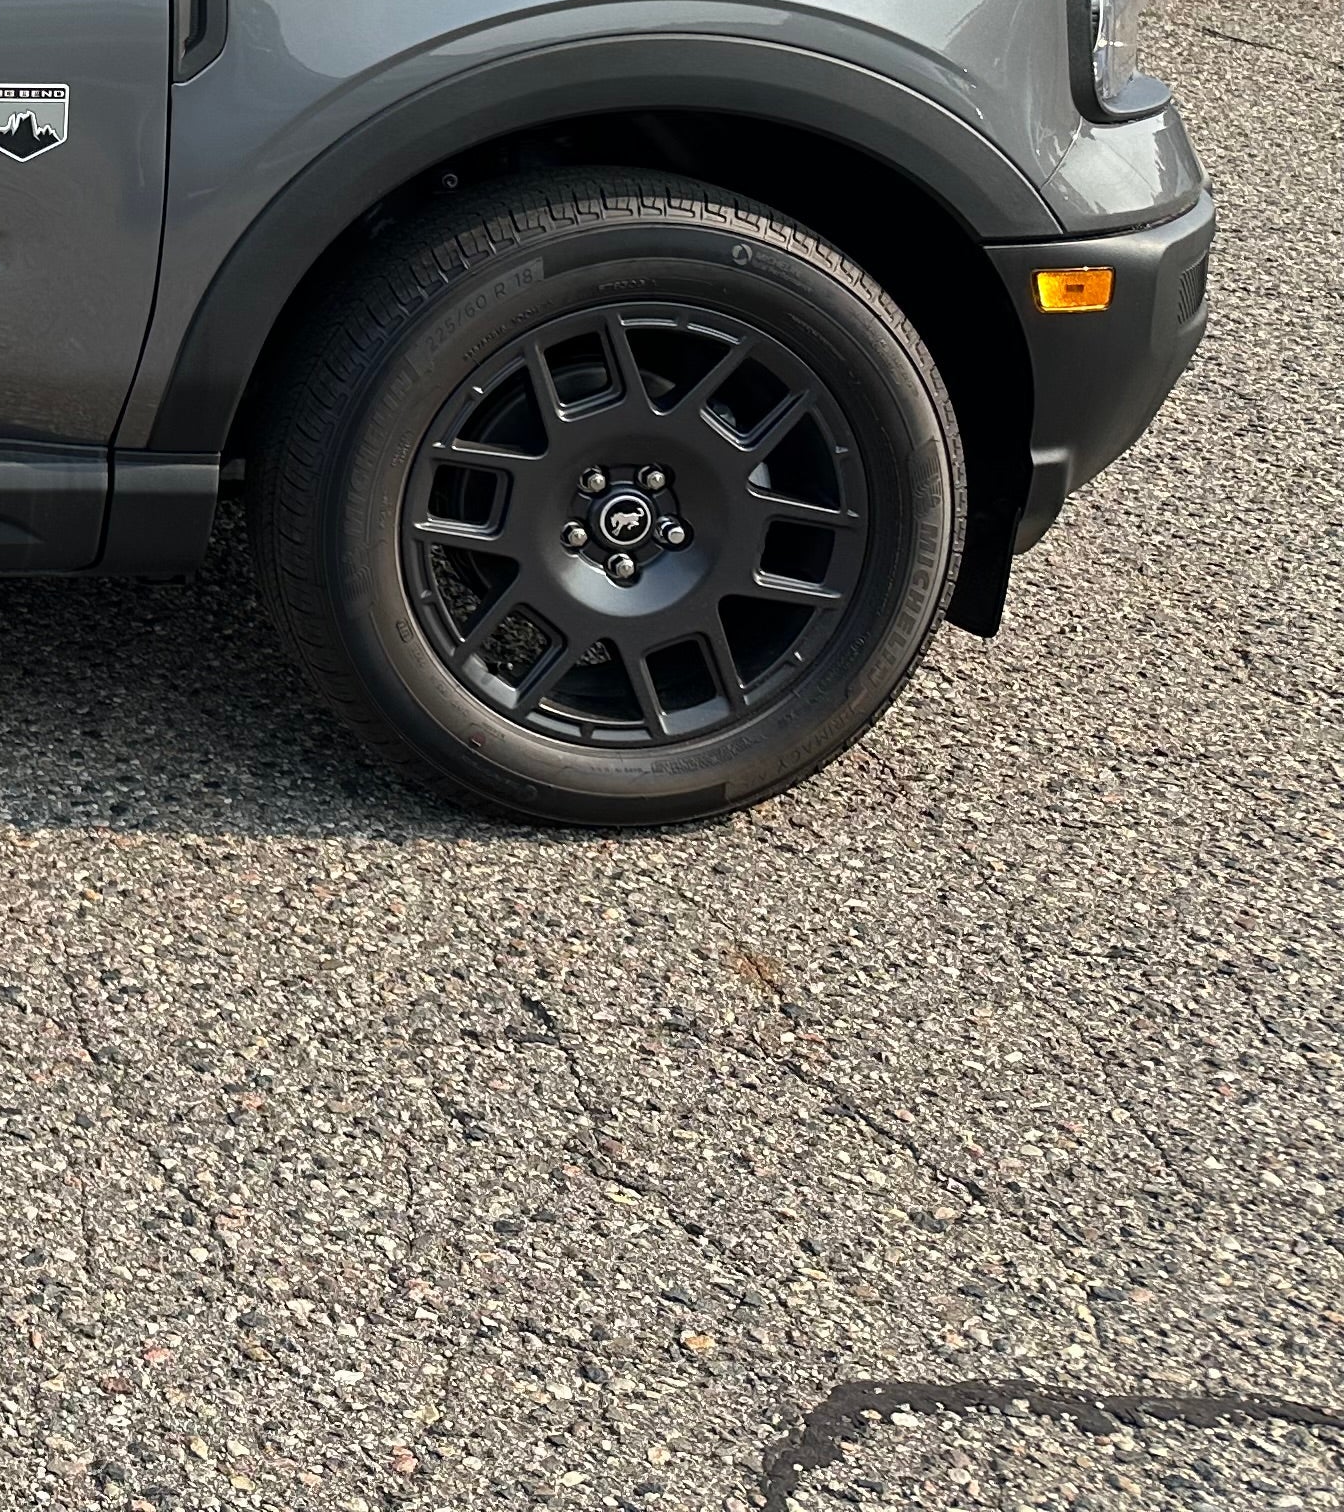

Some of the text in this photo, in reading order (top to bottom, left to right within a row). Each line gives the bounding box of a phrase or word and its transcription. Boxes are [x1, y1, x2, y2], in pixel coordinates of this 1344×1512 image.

[19, 89, 65, 99] BEND
[423, 267, 534, 353] 225/60 R 18
[343, 367, 416, 537] MICHELIN
[862, 522, 938, 690] MICHELIN
